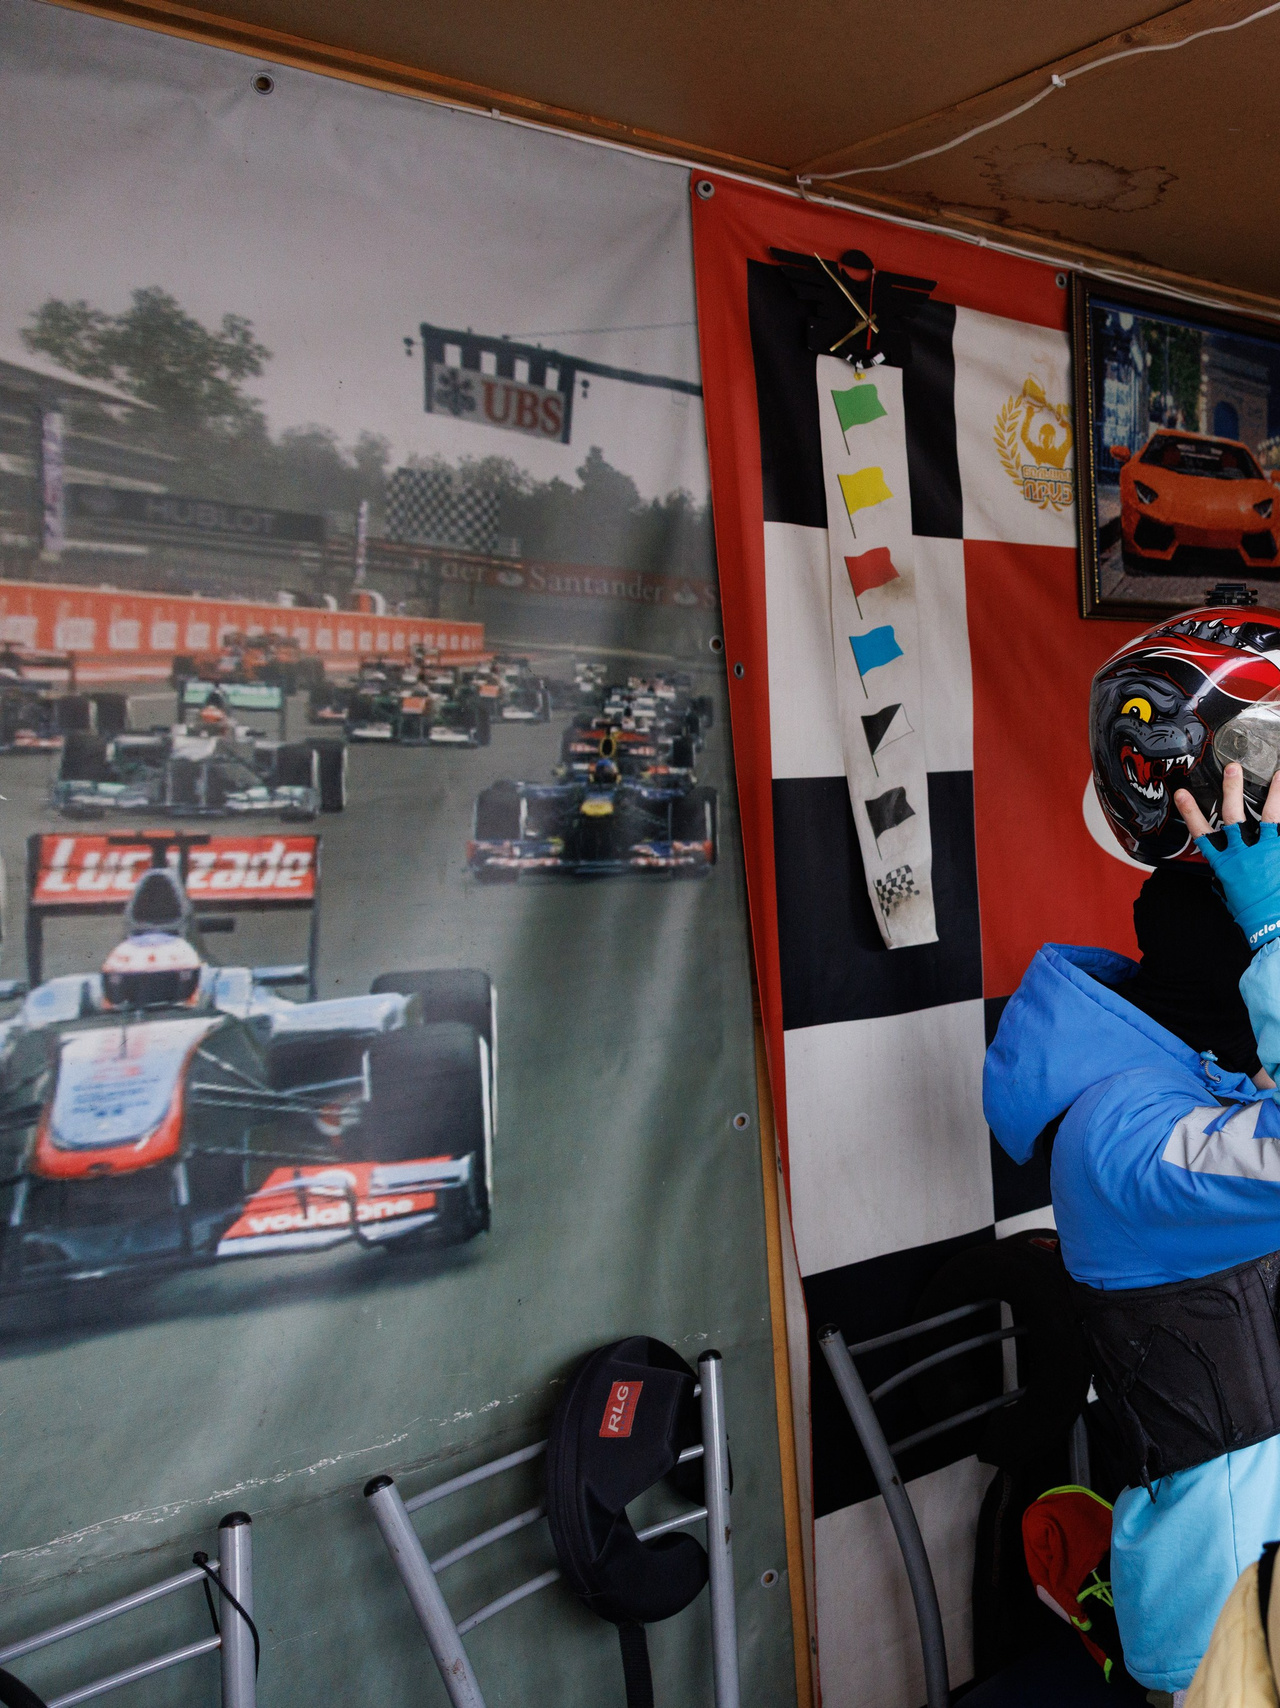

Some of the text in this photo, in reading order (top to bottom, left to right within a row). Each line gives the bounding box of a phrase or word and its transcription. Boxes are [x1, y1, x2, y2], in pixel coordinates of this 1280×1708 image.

[480, 378, 564, 437] UBS
[529, 565, 666, 601] Santander
[607, 1384, 630, 1433] RLG
